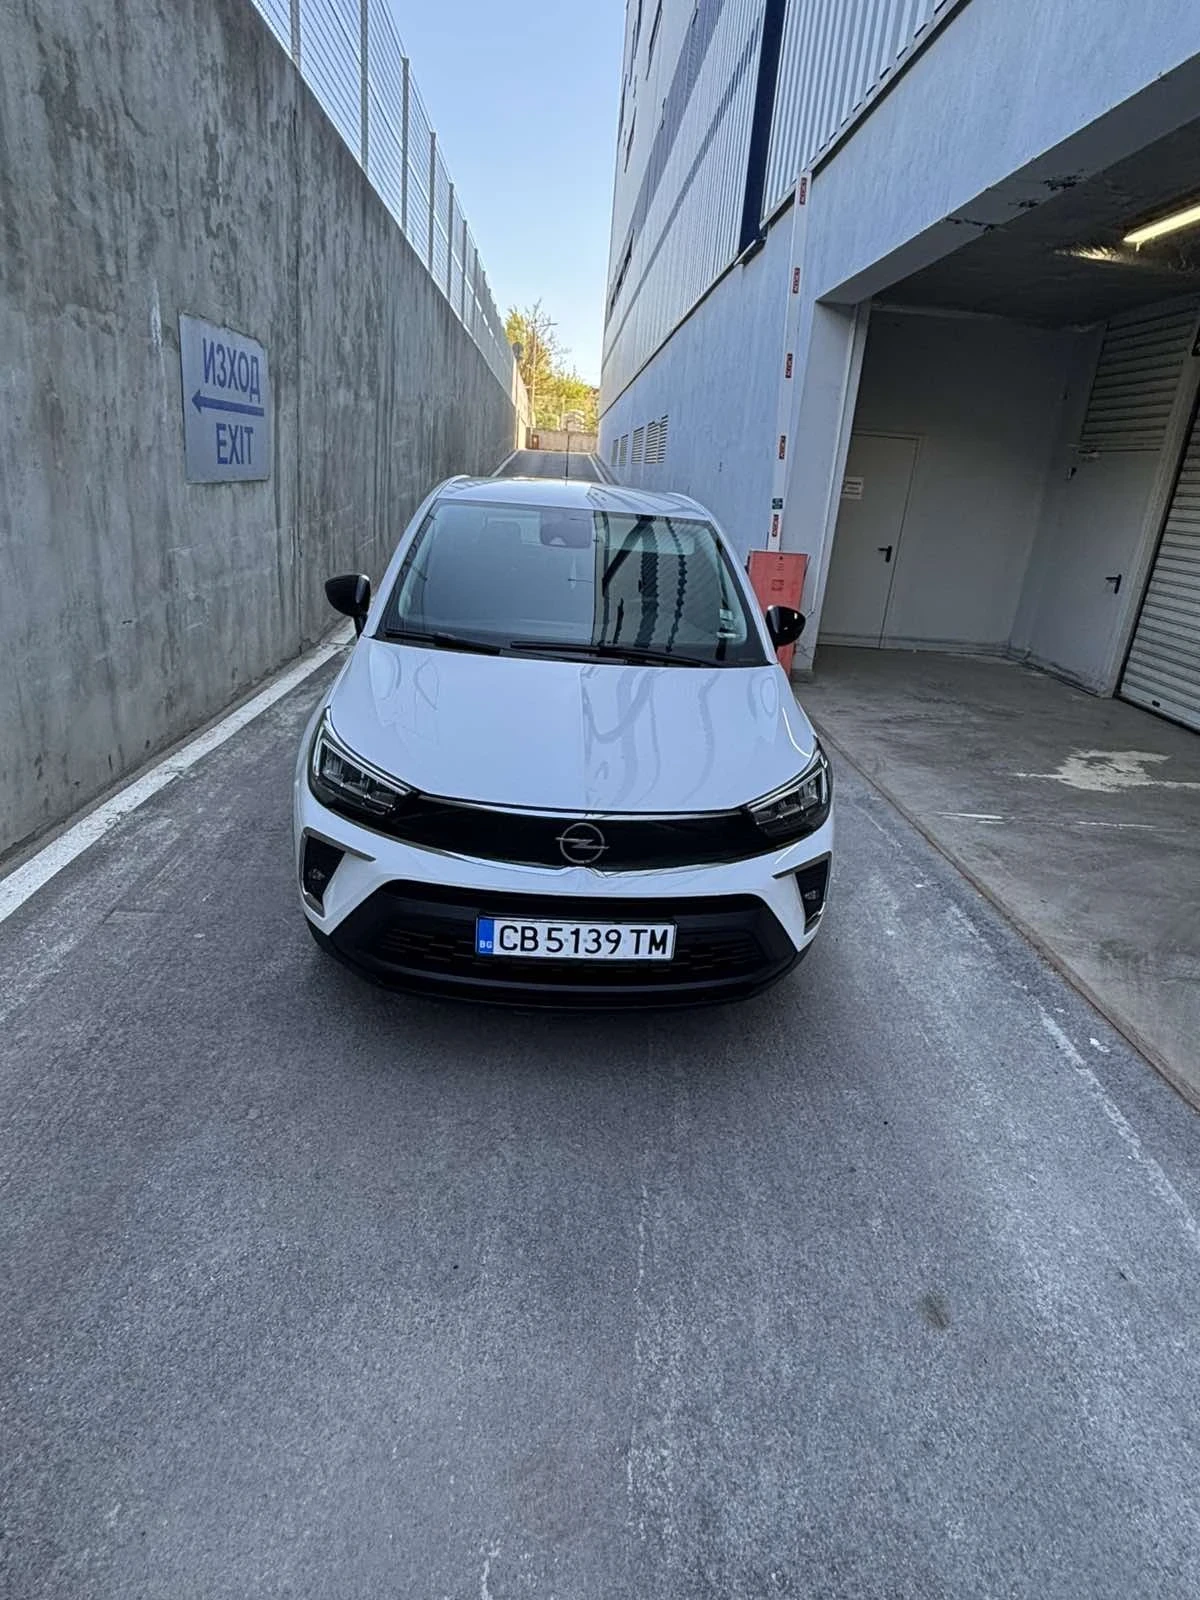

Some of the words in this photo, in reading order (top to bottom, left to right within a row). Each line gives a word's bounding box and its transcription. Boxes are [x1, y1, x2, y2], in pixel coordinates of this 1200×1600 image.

[202, 337, 261, 404] ИЗХОД
[215, 422, 254, 465] EXIT
[479, 939, 493, 949] BG
[545, 927, 623, 955] 5139
[629, 928, 669, 956] TM
